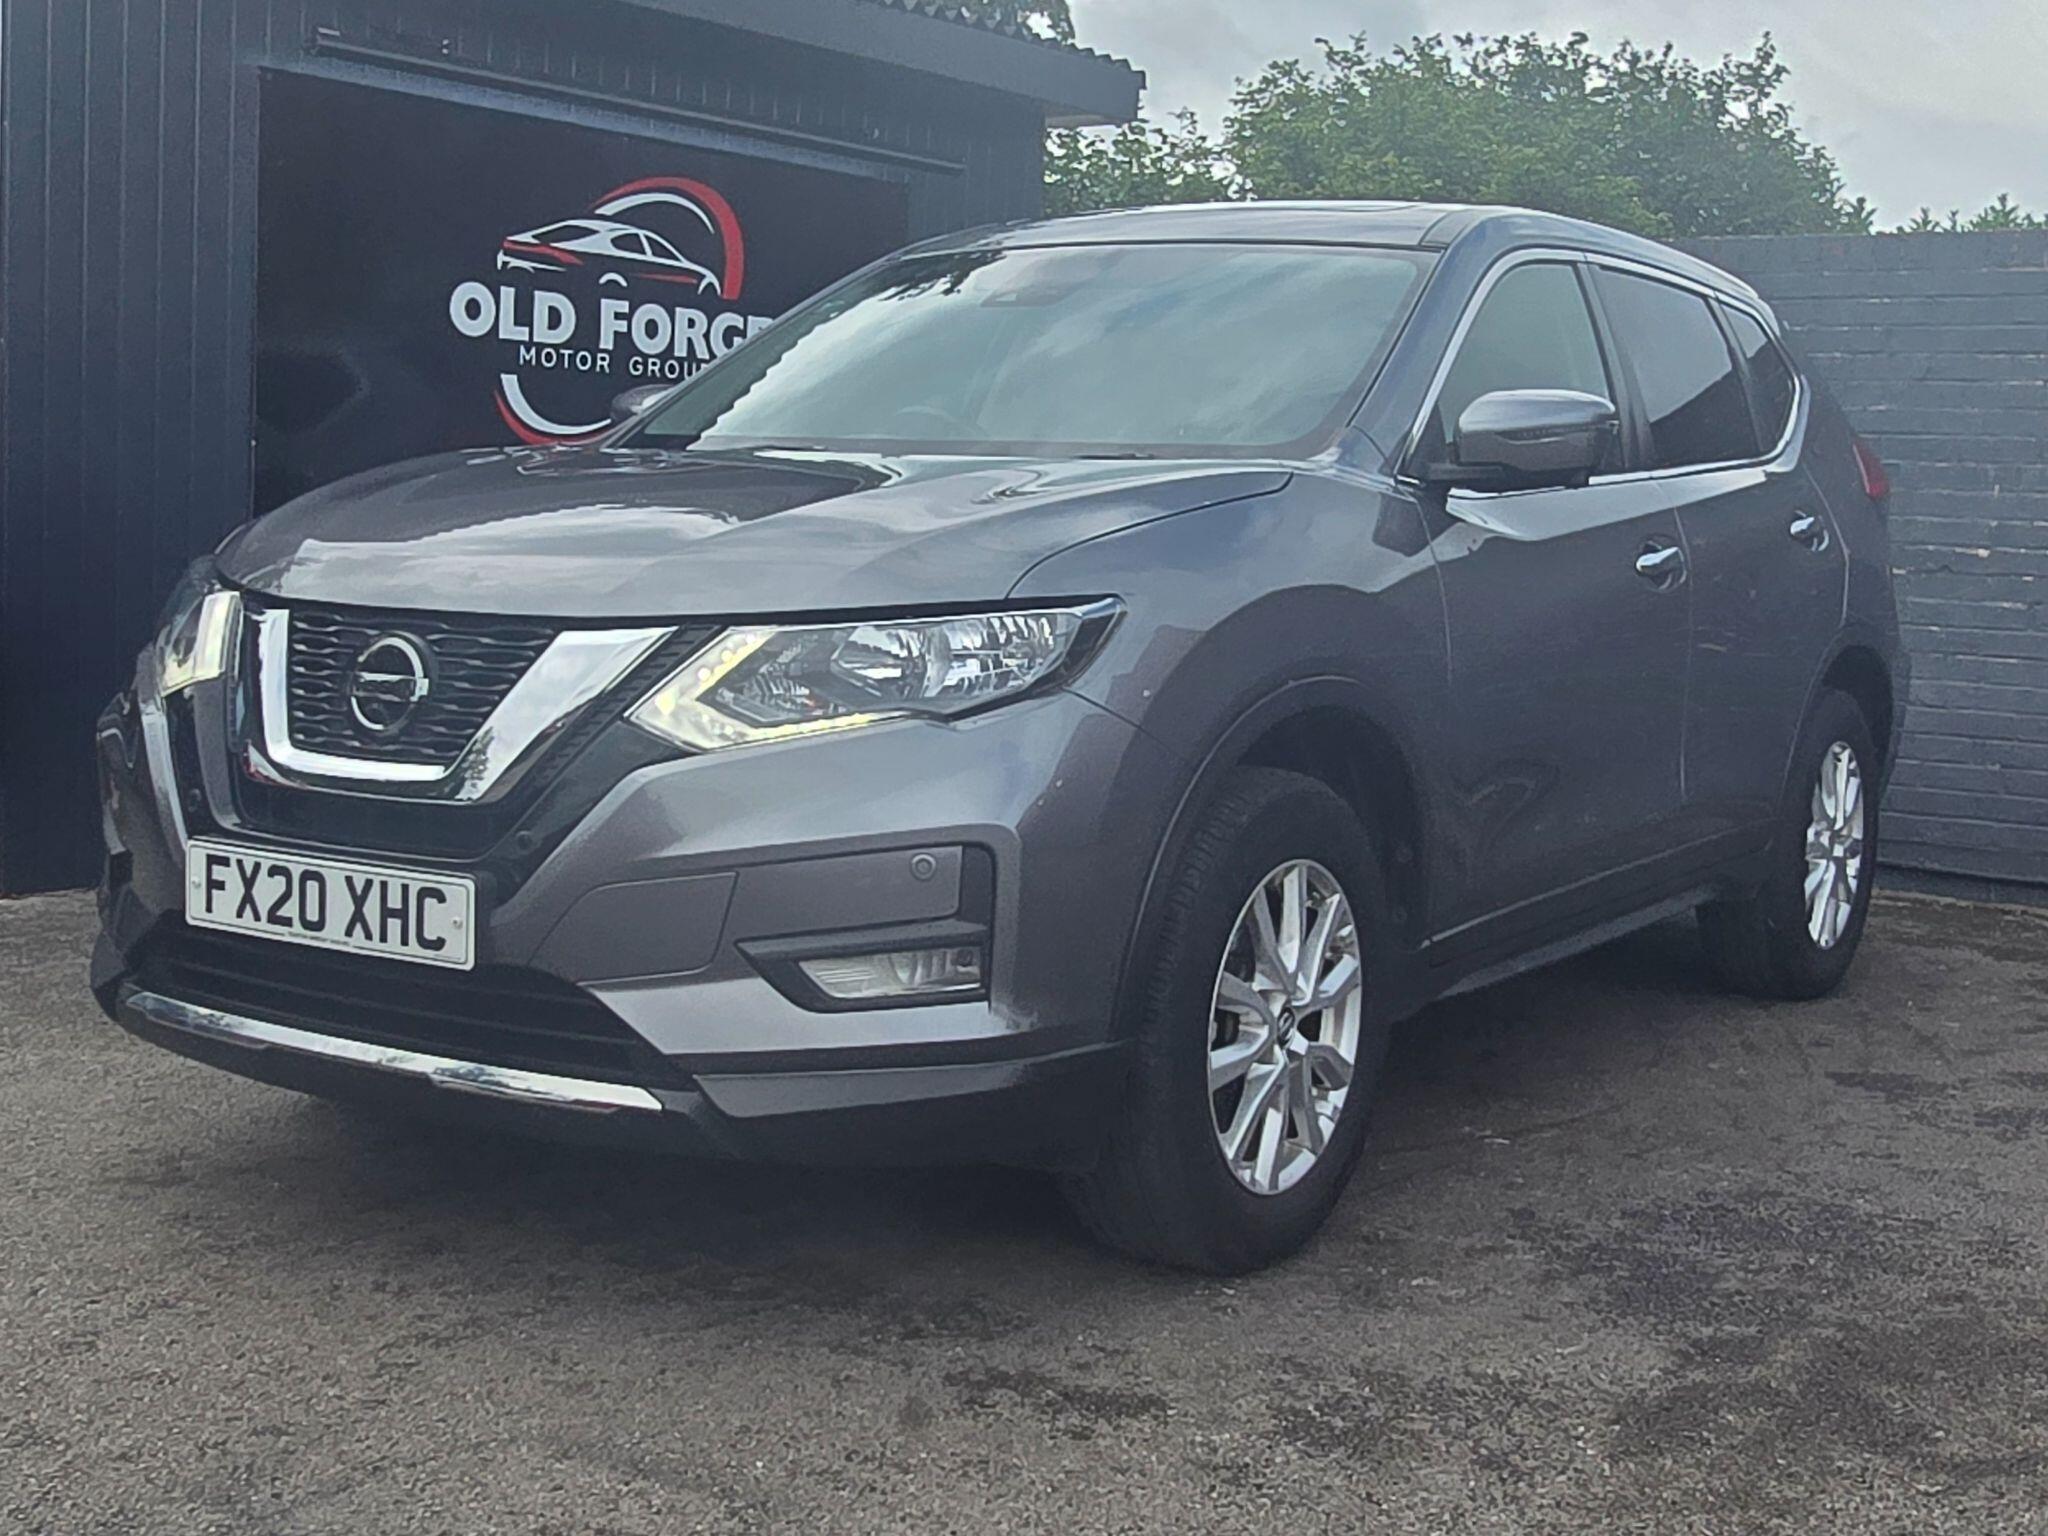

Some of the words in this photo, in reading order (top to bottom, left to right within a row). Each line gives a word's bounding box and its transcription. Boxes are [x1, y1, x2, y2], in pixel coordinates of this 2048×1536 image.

[449, 281, 576, 344] OLD
[519, 345, 610, 373] MOTOR
[629, 357, 709, 380] GROU
[205, 853, 327, 932] FX20
[344, 875, 447, 951] XHC
